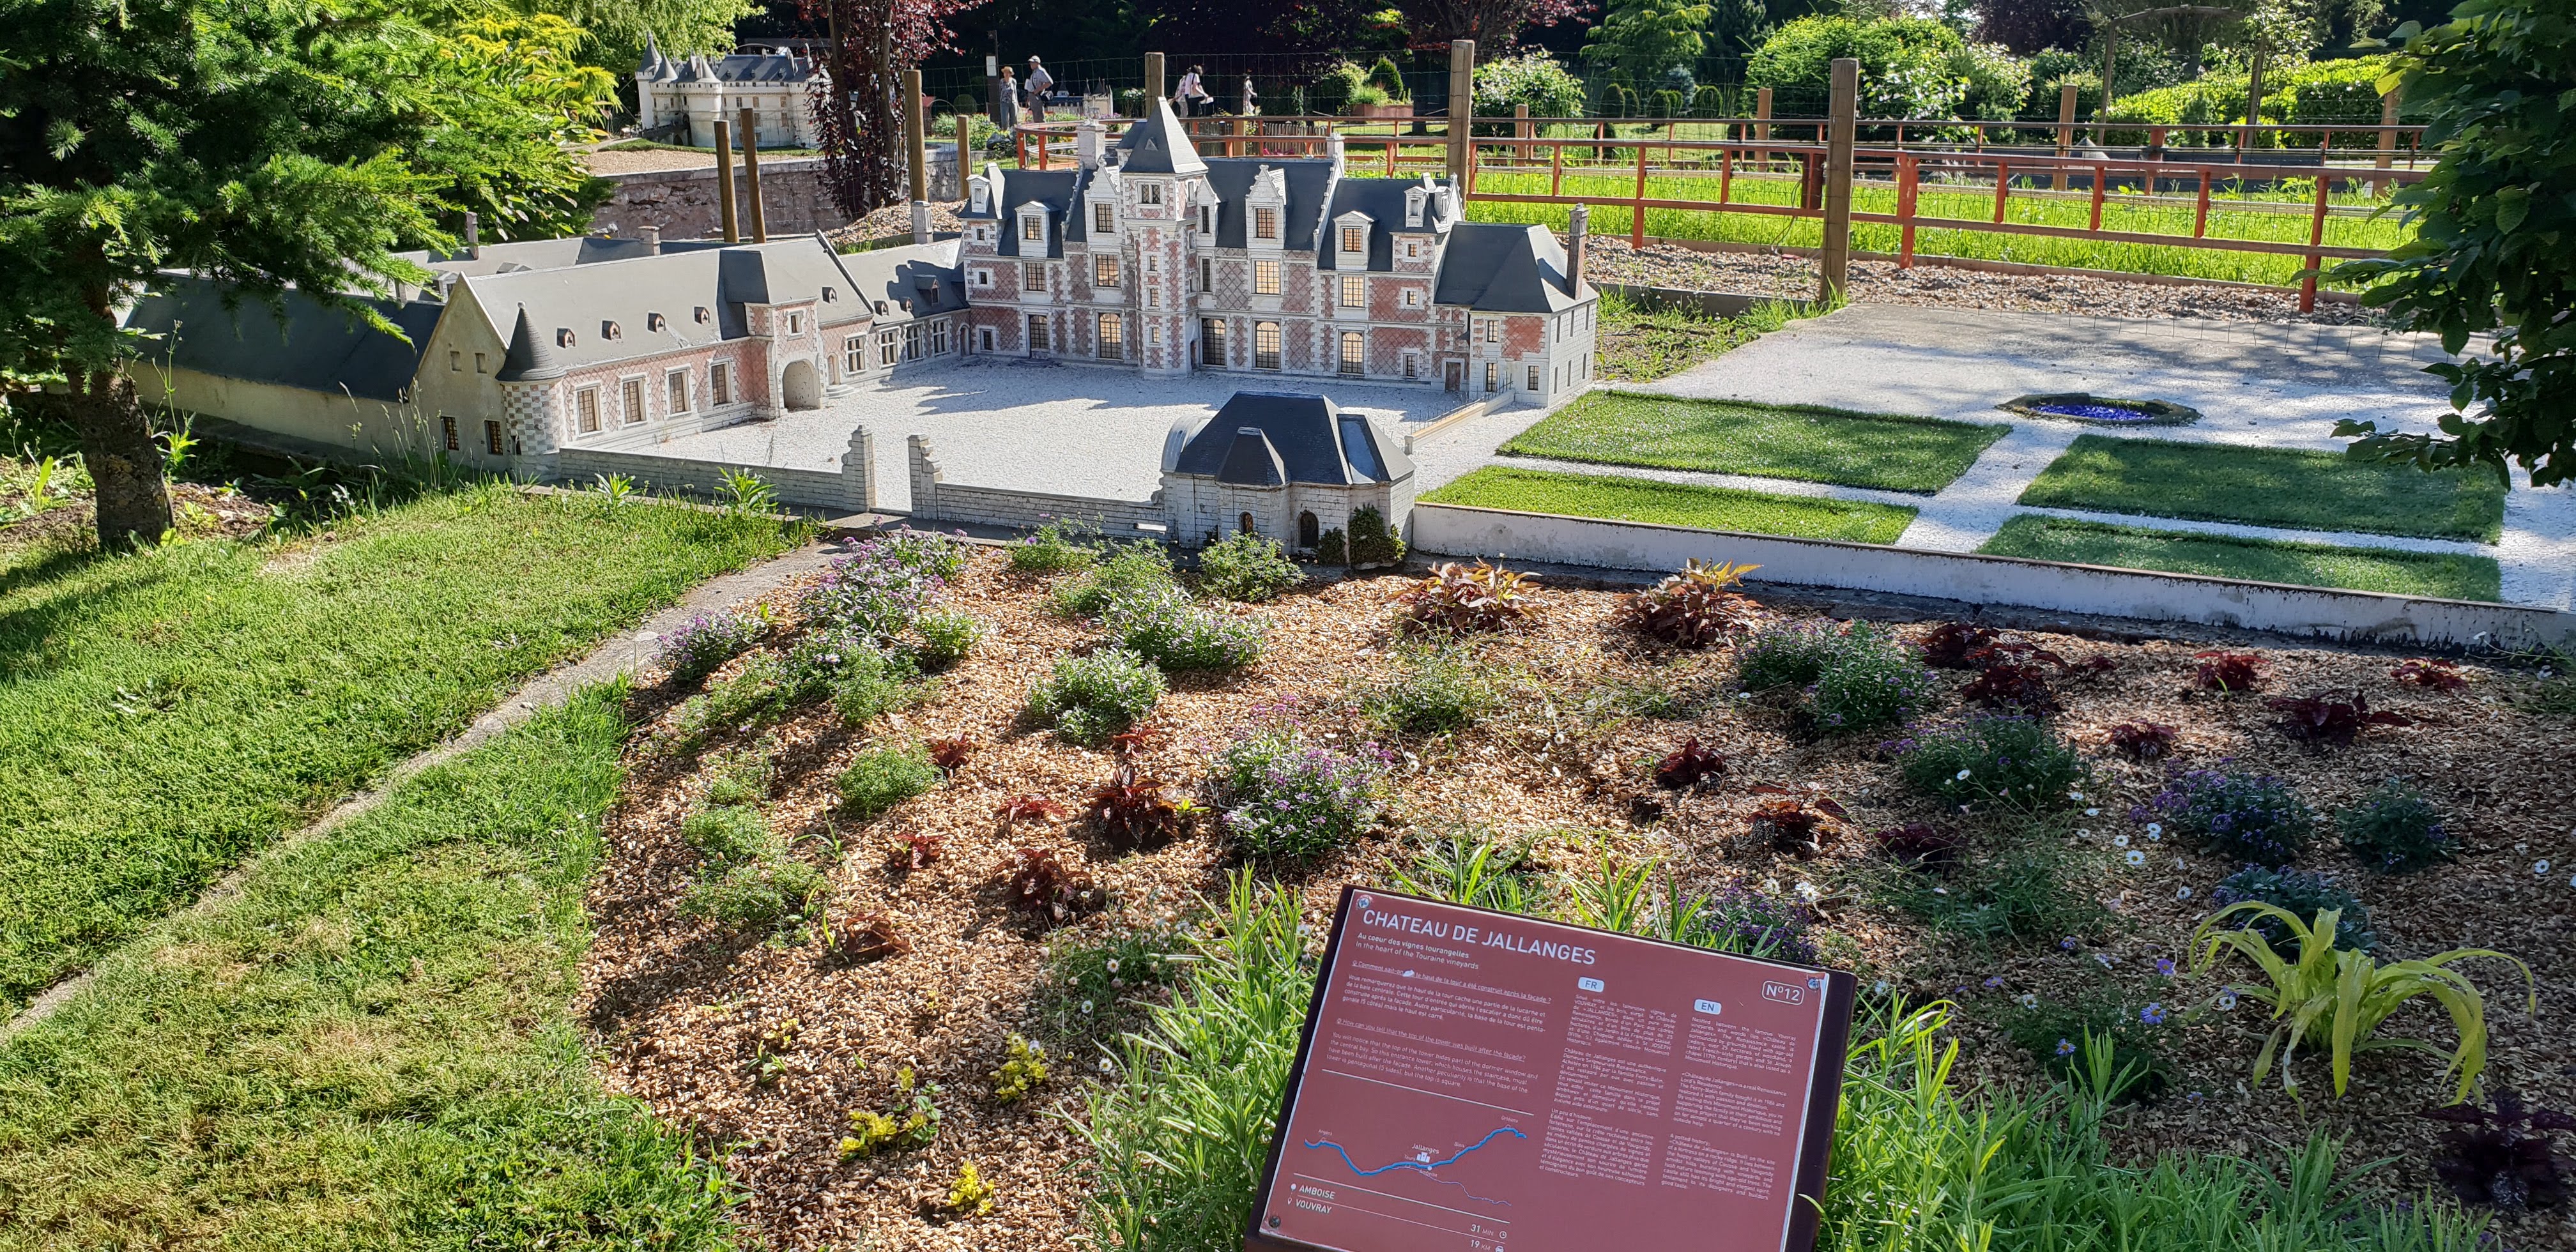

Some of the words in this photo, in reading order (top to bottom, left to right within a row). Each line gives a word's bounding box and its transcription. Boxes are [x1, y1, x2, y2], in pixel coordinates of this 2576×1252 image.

[1363, 910, 1448, 938] CHATEAU
[1452, 925, 1479, 944] DE
[1481, 931, 1596, 965] JALLANGES
[1375, 945, 1393, 954] heart
[1416, 952, 1445, 963] Touraine
[1446, 959, 1479, 970] vineyards
[1402, 941, 1424, 950] vignes
[1425, 945, 1469, 959] tourangelles
[1585, 980, 1597, 989] FR
[1701, 1002, 1714, 1011] EN
[1411, 1143, 1439, 1154] Jallanges
[1299, 1185, 1336, 1200] AMBOISE
[1470, 1224, 1480, 1233] 31
[1296, 1199, 1332, 1214] VOUVRAY
[1471, 1239, 1480, 1248] 19
